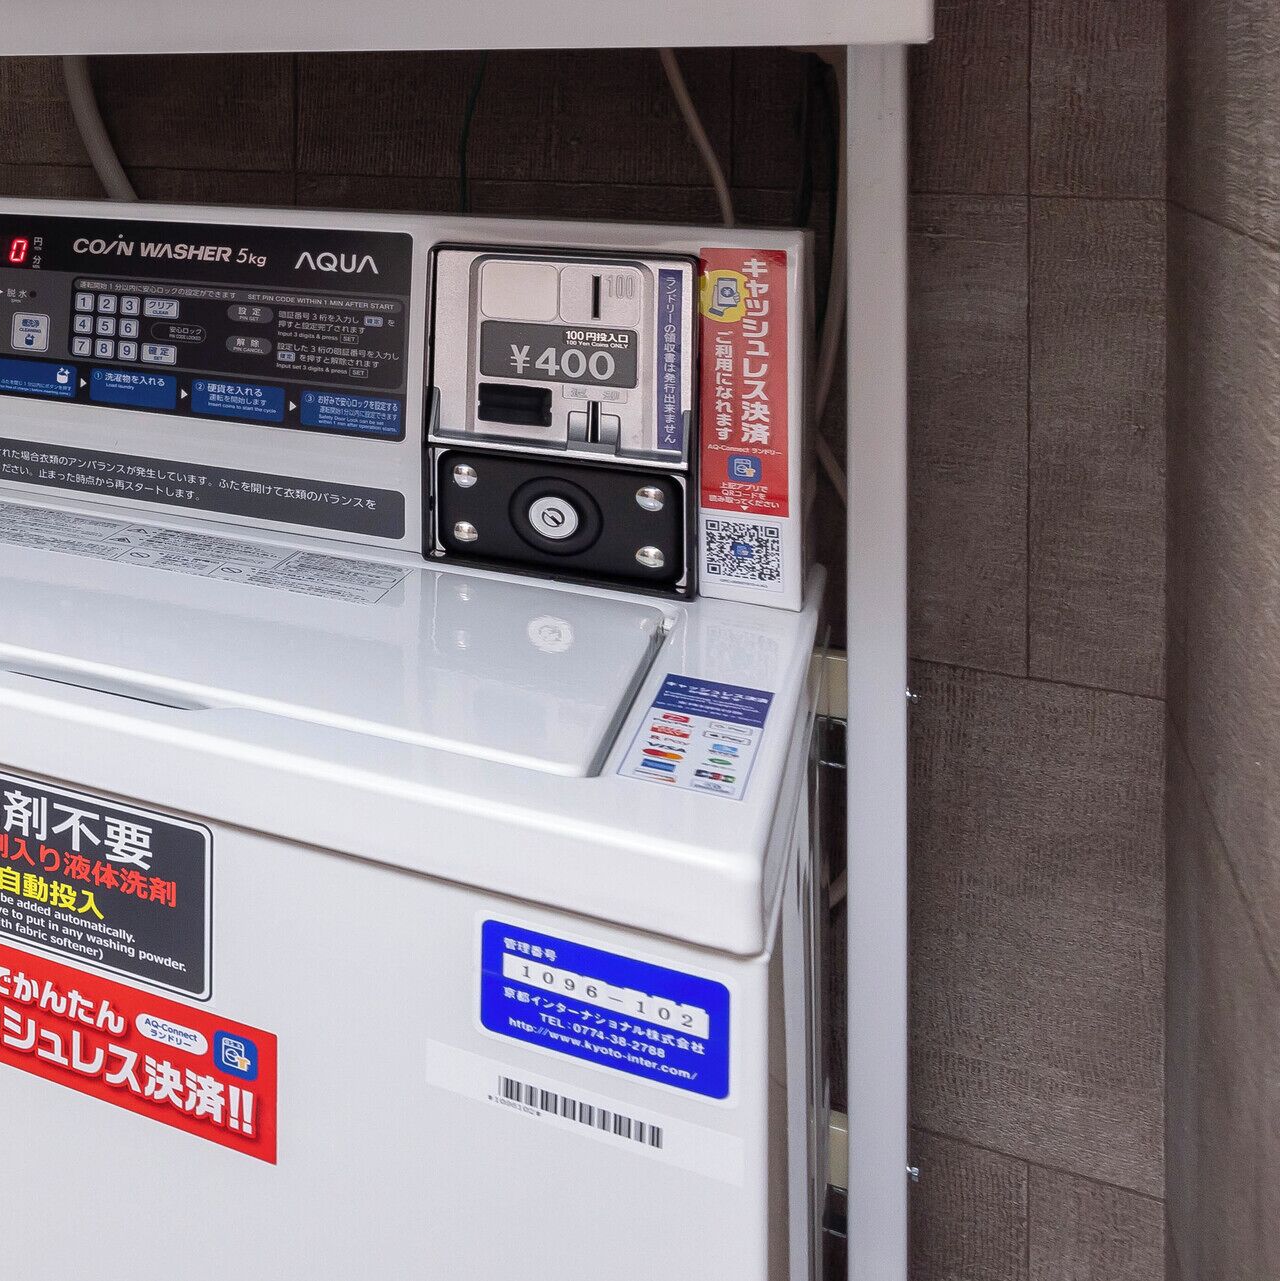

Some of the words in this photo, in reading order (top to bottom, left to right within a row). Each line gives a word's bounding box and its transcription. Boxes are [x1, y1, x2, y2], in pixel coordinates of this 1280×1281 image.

[10, 238, 29, 263] 0
[140, 241, 232, 262] WASHER
[236, 248, 267, 267] 5kg
[295, 251, 379, 274] AQUA
[148, 300, 175, 311] クリア
[565, 330, 629, 344] 100円投入口
[148, 347, 170, 357] 確定
[510, 344, 615, 381] ¥400
[664, 276, 677, 445] ランドリーの領収書は発行出来ません
[741, 258, 771, 446] キャッシュレス決済
[104, 372, 165, 387] 洗濯物を入れる
[208, 383, 263, 397] 硬貨を入れる
[714, 330, 734, 441] ご利用になれます
[647, 741, 686, 753] VISA
[0, 890, 14, 906] be
[16, 896, 51, 916] added
[54, 908, 135, 944] automatically.
[12, 909, 23, 920] to
[26, 912, 44, 929] put
[48, 918, 58, 931] in
[61, 924, 83, 942] any
[86, 931, 135, 958] washing
[138, 947, 186, 973] powder.
[15, 920, 47, 942] fabric
[50, 931, 104, 960] softener)
[503, 936, 557, 963] 管理番号
[144, 1016, 199, 1043] AQ-Connect
[503, 985, 706, 1056] 京都インターナショナル株式会社
[150, 1028, 191, 1051] ランドリー
